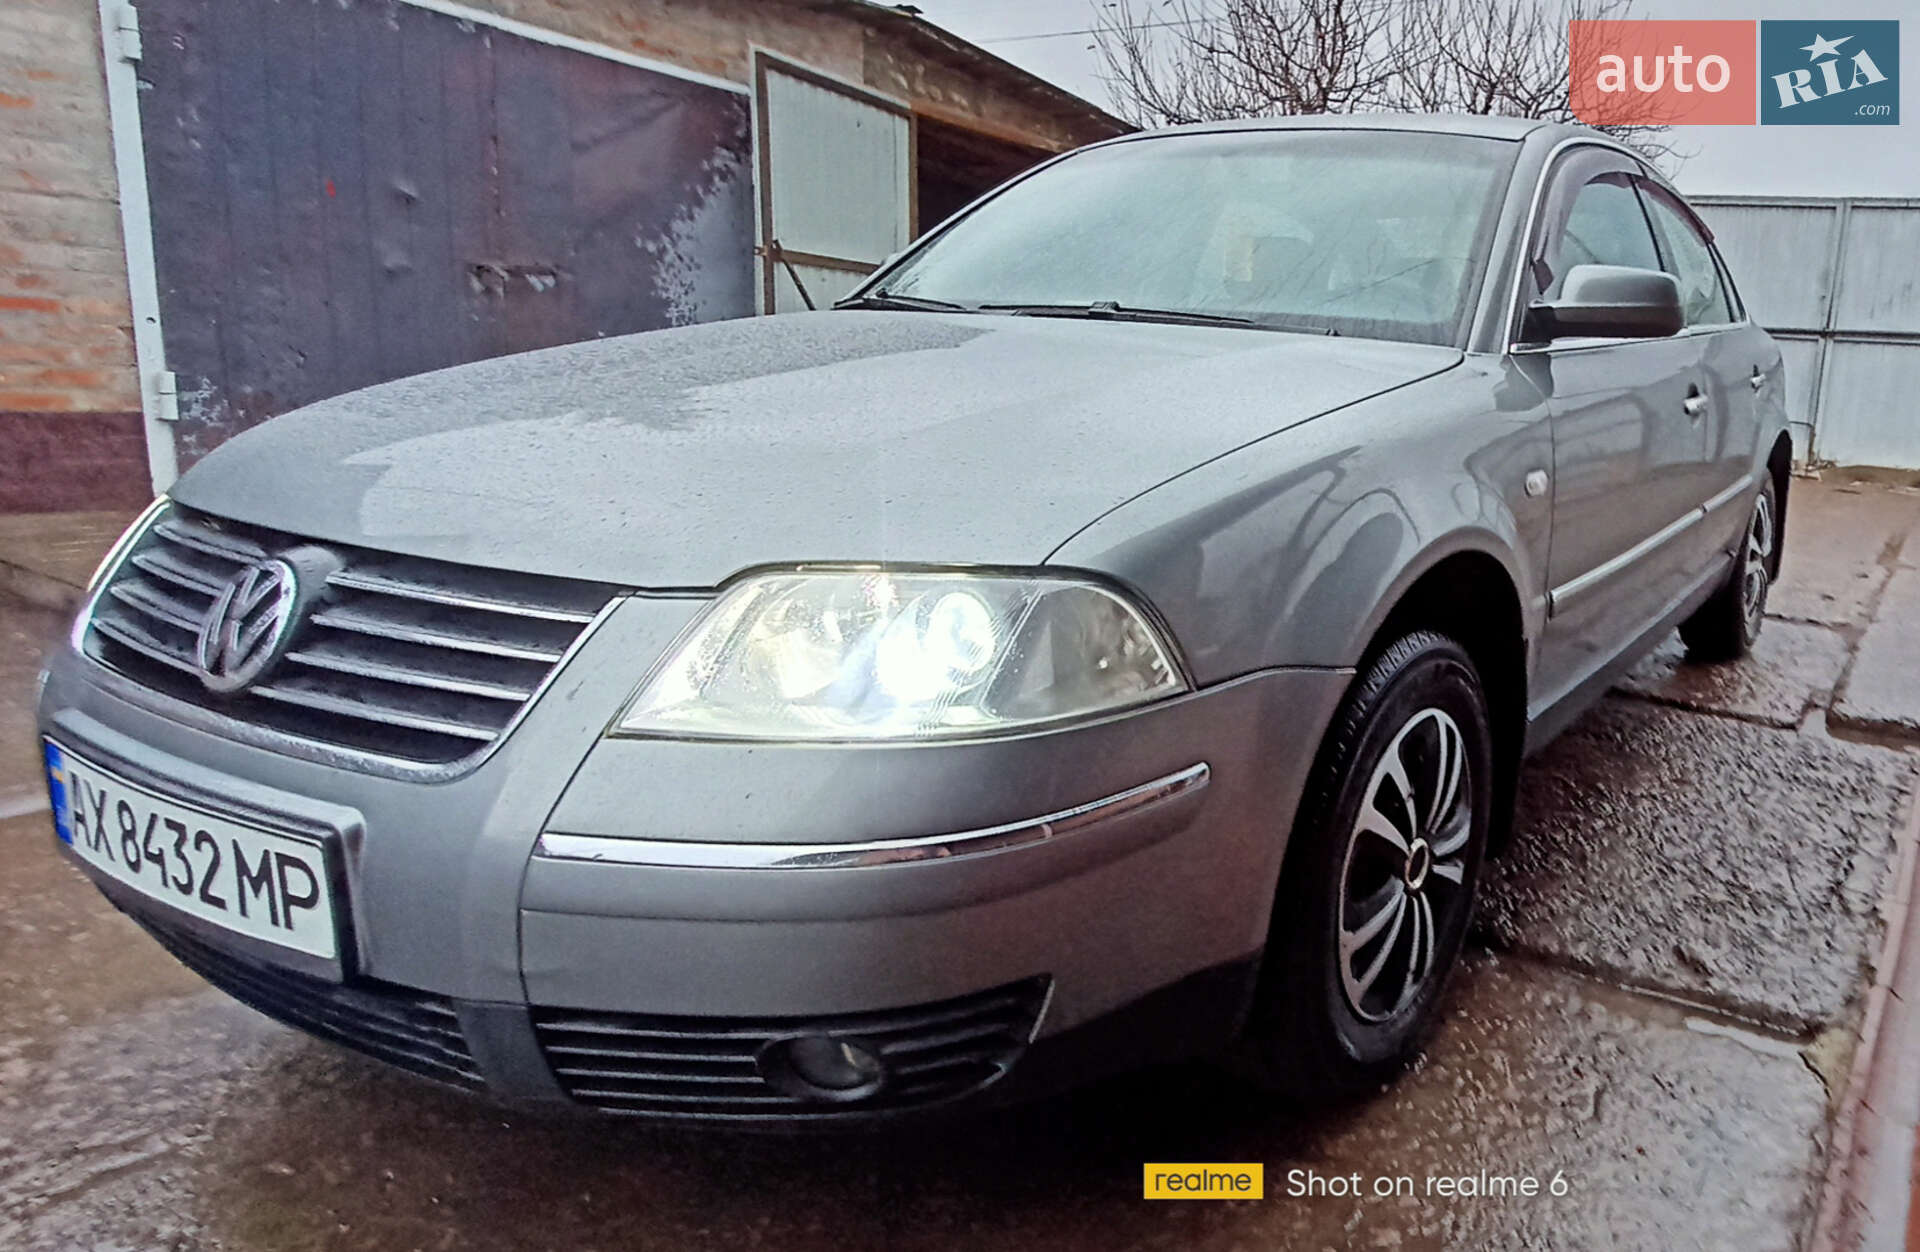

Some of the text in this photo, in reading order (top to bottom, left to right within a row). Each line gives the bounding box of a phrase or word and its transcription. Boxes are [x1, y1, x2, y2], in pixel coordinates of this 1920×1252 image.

[69, 770, 320, 931] AX 8432 MP
